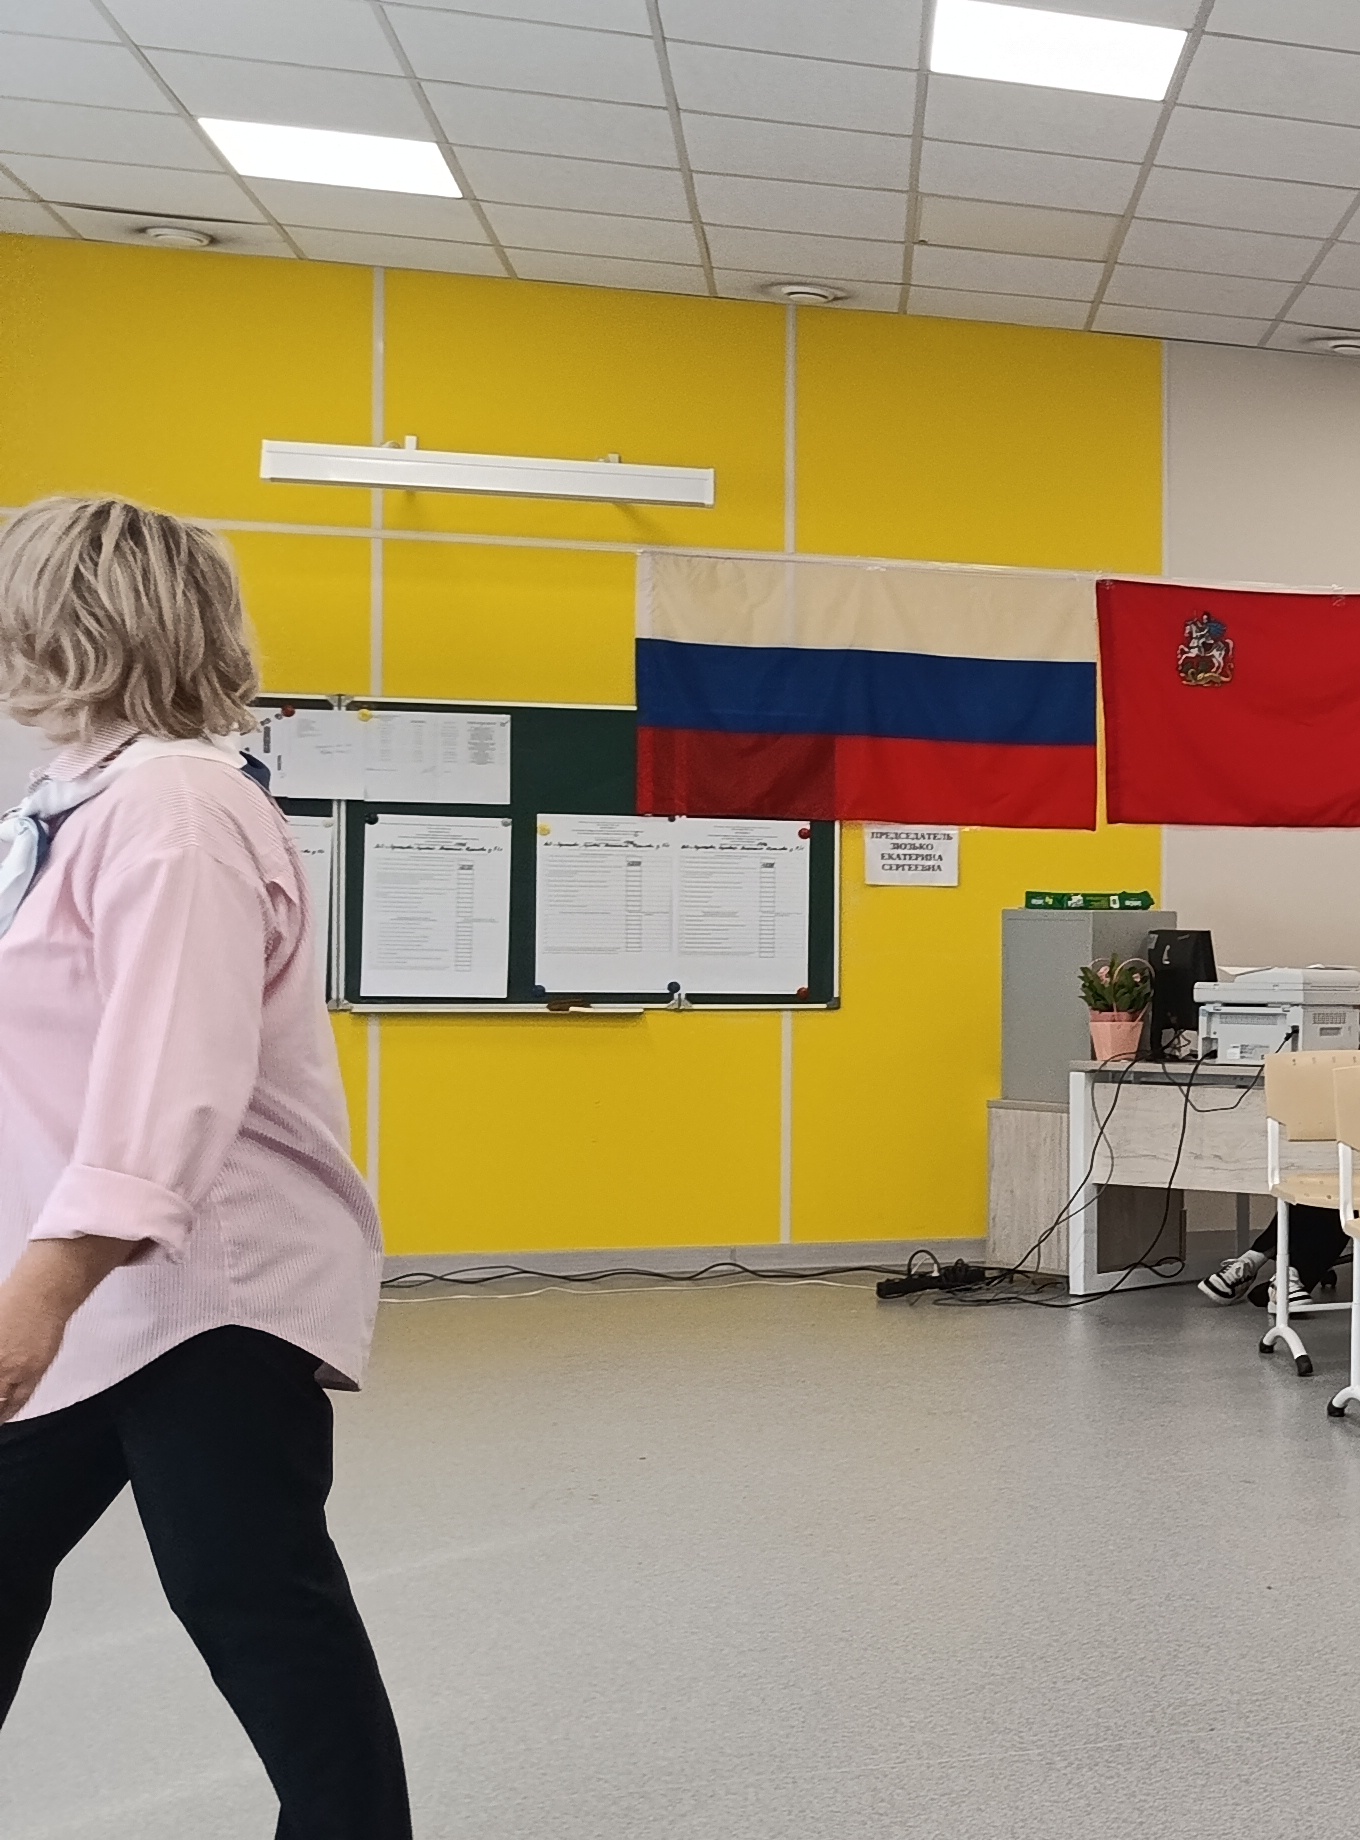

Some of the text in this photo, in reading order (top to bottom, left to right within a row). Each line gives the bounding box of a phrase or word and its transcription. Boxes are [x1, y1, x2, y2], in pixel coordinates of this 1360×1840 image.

[870, 832, 953, 841] ПРЕДСЕДАТЕЛЬ
[880, 853, 943, 862] ЕКАТЕРИНА
[881, 863, 942, 872] СЕРГЕЕВНА
